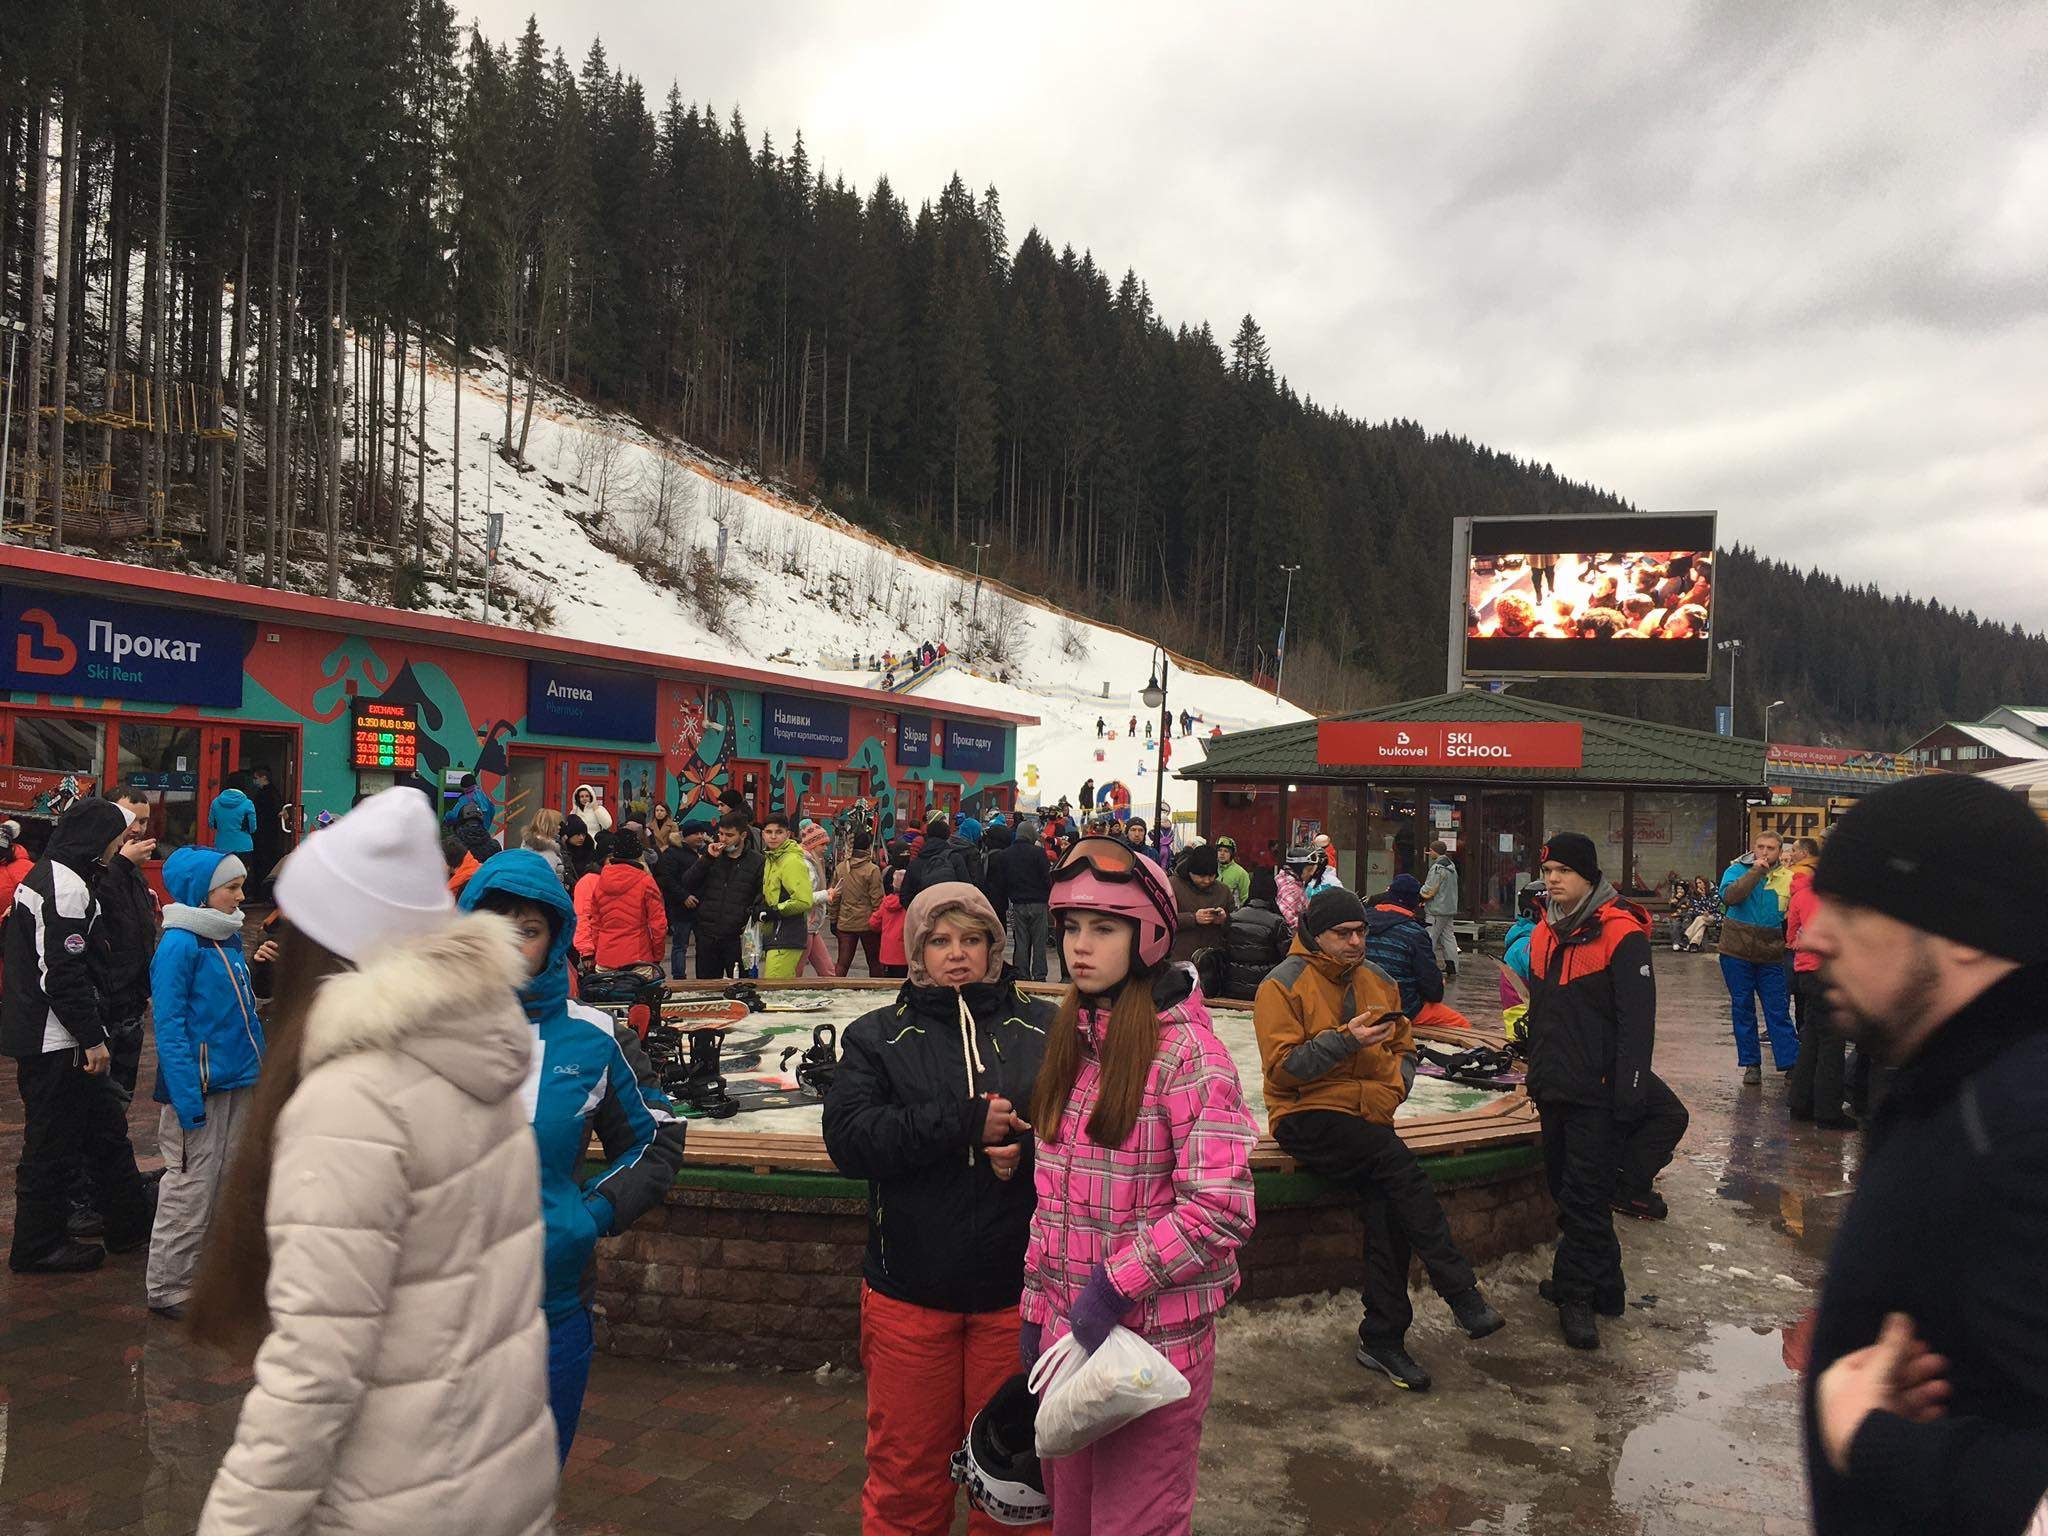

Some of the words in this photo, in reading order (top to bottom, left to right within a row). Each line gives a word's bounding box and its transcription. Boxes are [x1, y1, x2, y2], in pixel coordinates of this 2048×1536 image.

[88, 619, 201, 663] Прокат
[87, 663, 109, 680] Ski
[112, 666, 144, 683] Rent
[546, 679, 593, 701] Аптека
[369, 705, 405, 716] EXCHANGE
[774, 708, 811, 727] Наливки
[378, 733, 395, 743] USD
[904, 727, 928, 744] Skipass
[952, 732, 975, 748] Прокат
[1447, 732, 1473, 745] SKI
[379, 744, 394, 755] EUR
[1378, 745, 1428, 757] bukovel
[1446, 745, 1512, 758] SCHOOL
[1756, 811, 1820, 837] ТИР
